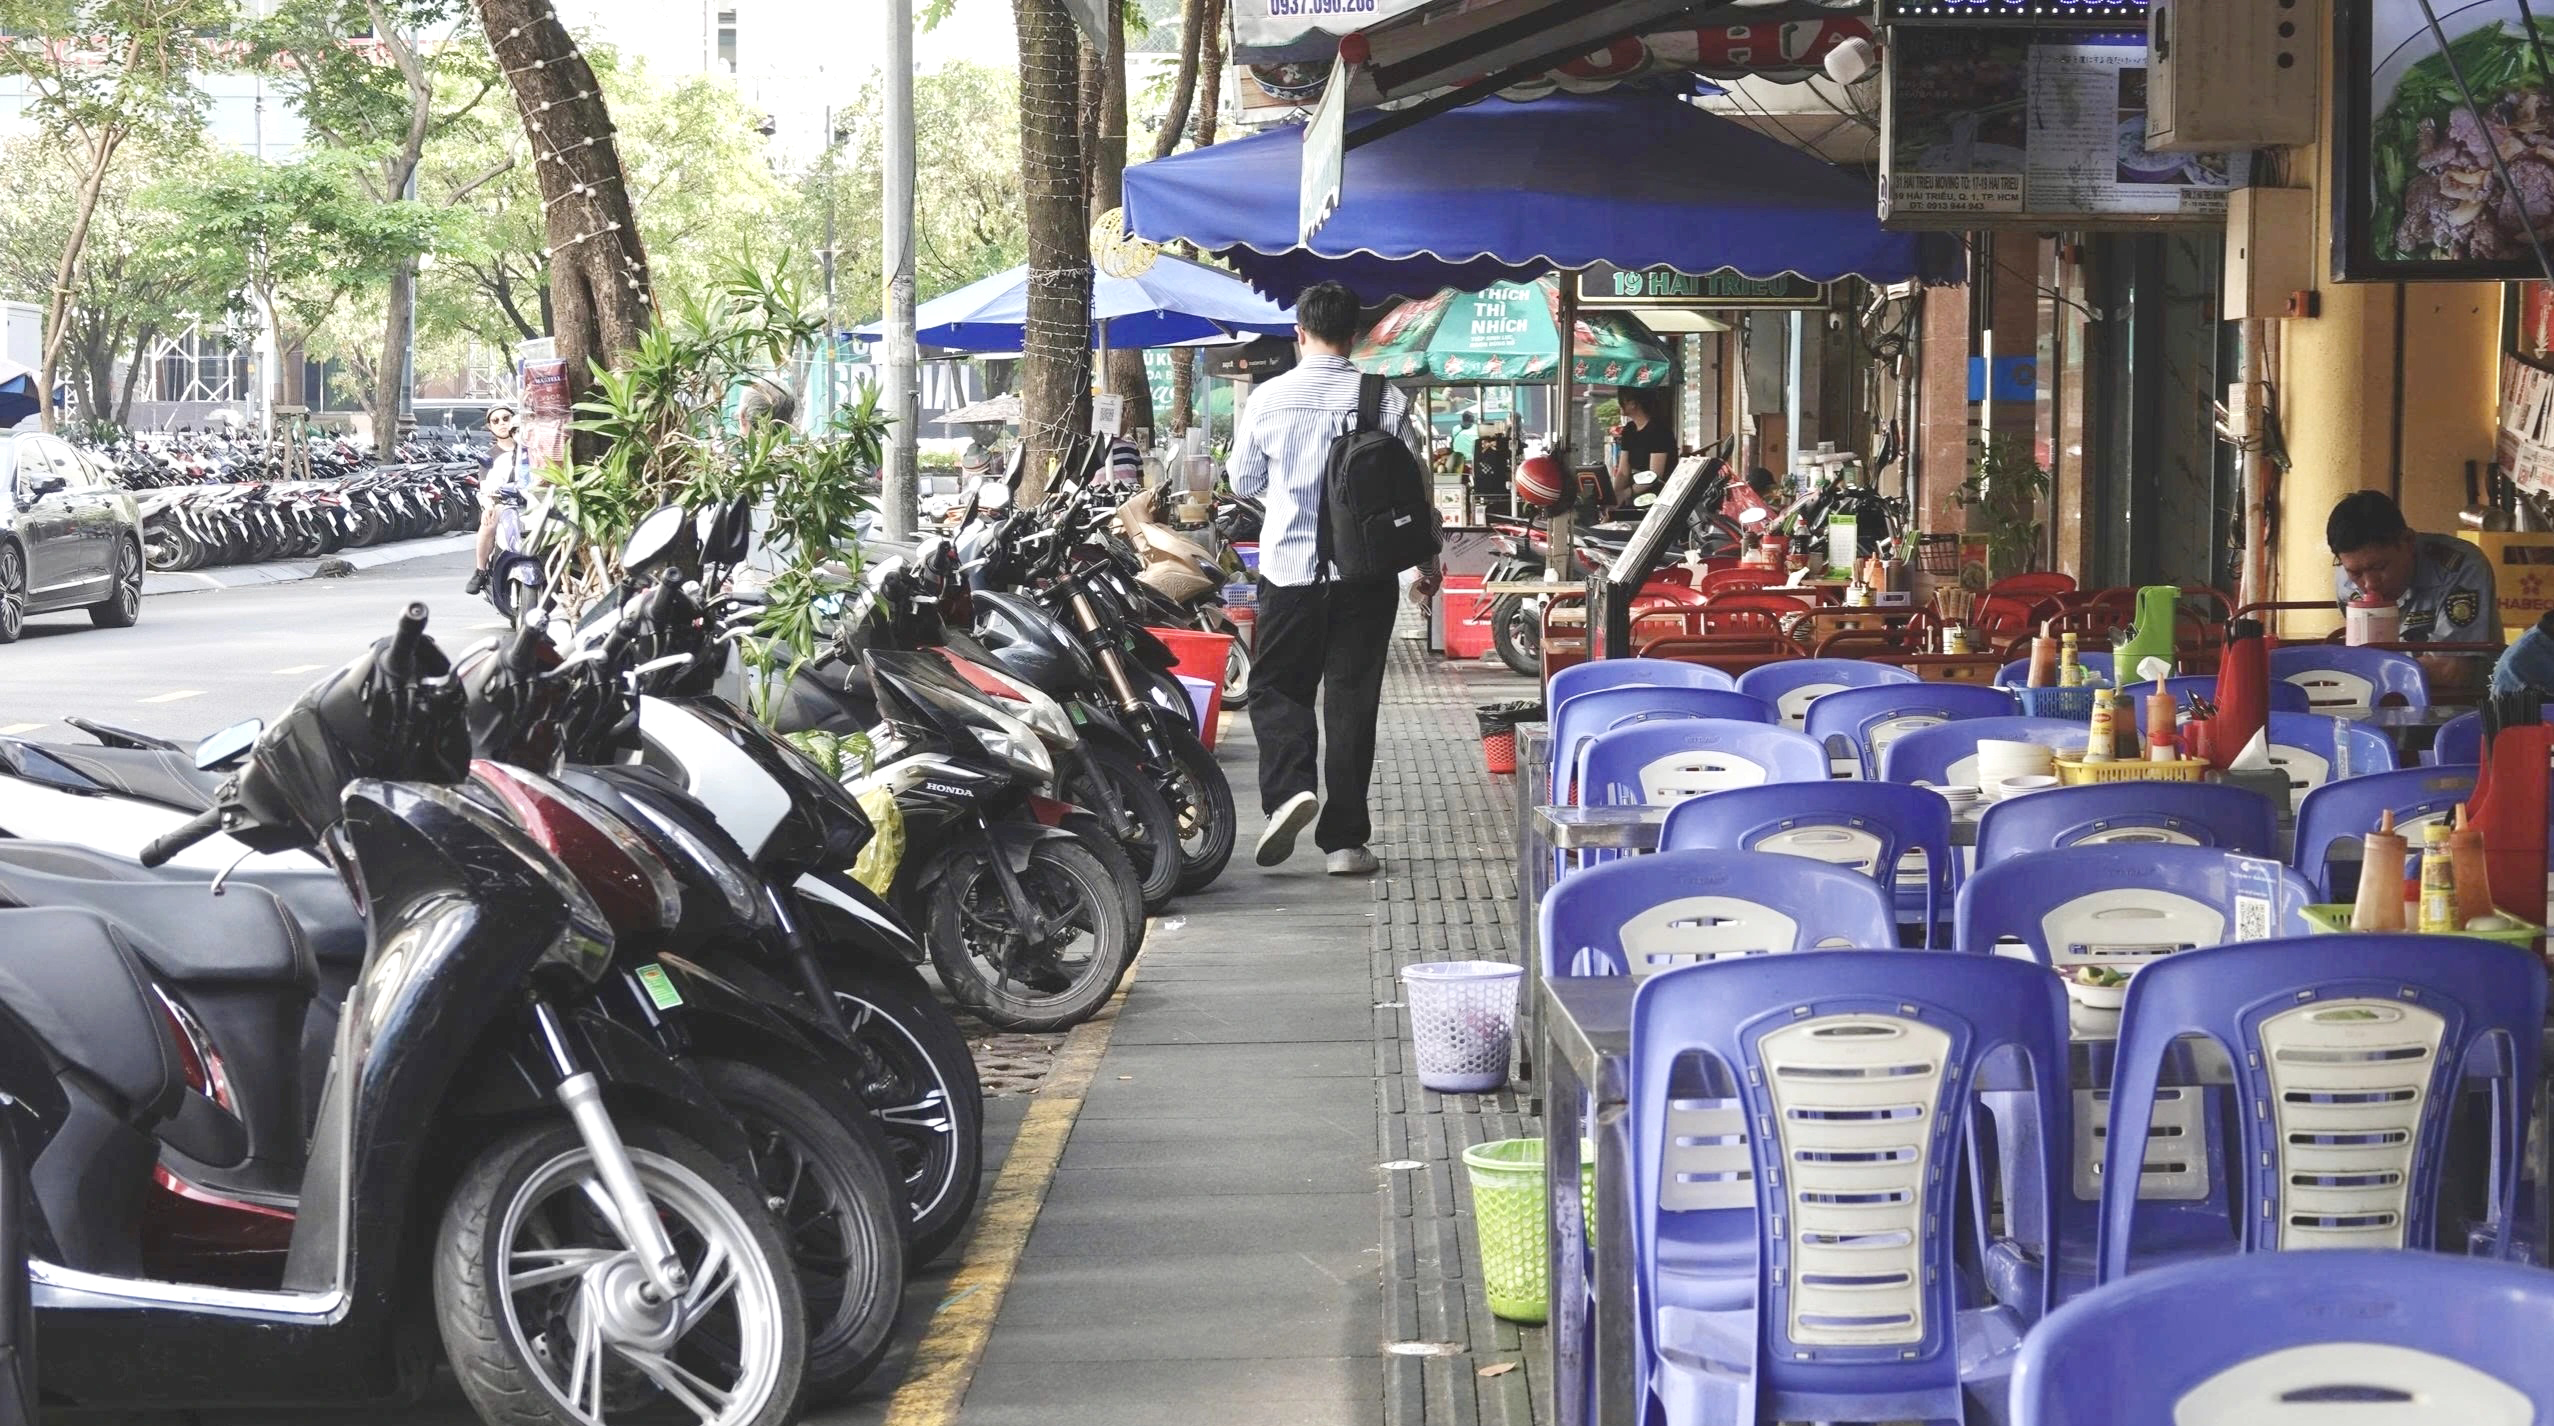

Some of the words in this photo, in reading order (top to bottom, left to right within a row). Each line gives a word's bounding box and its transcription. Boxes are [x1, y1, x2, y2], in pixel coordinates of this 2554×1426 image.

[1612, 271, 1643, 296] 19
[1478, 287, 1531, 301] THÍCH
[1473, 301, 1506, 317] THÌ
[1471, 317, 1528, 335] NHÍCH
[926, 782, 975, 798] HONDA
